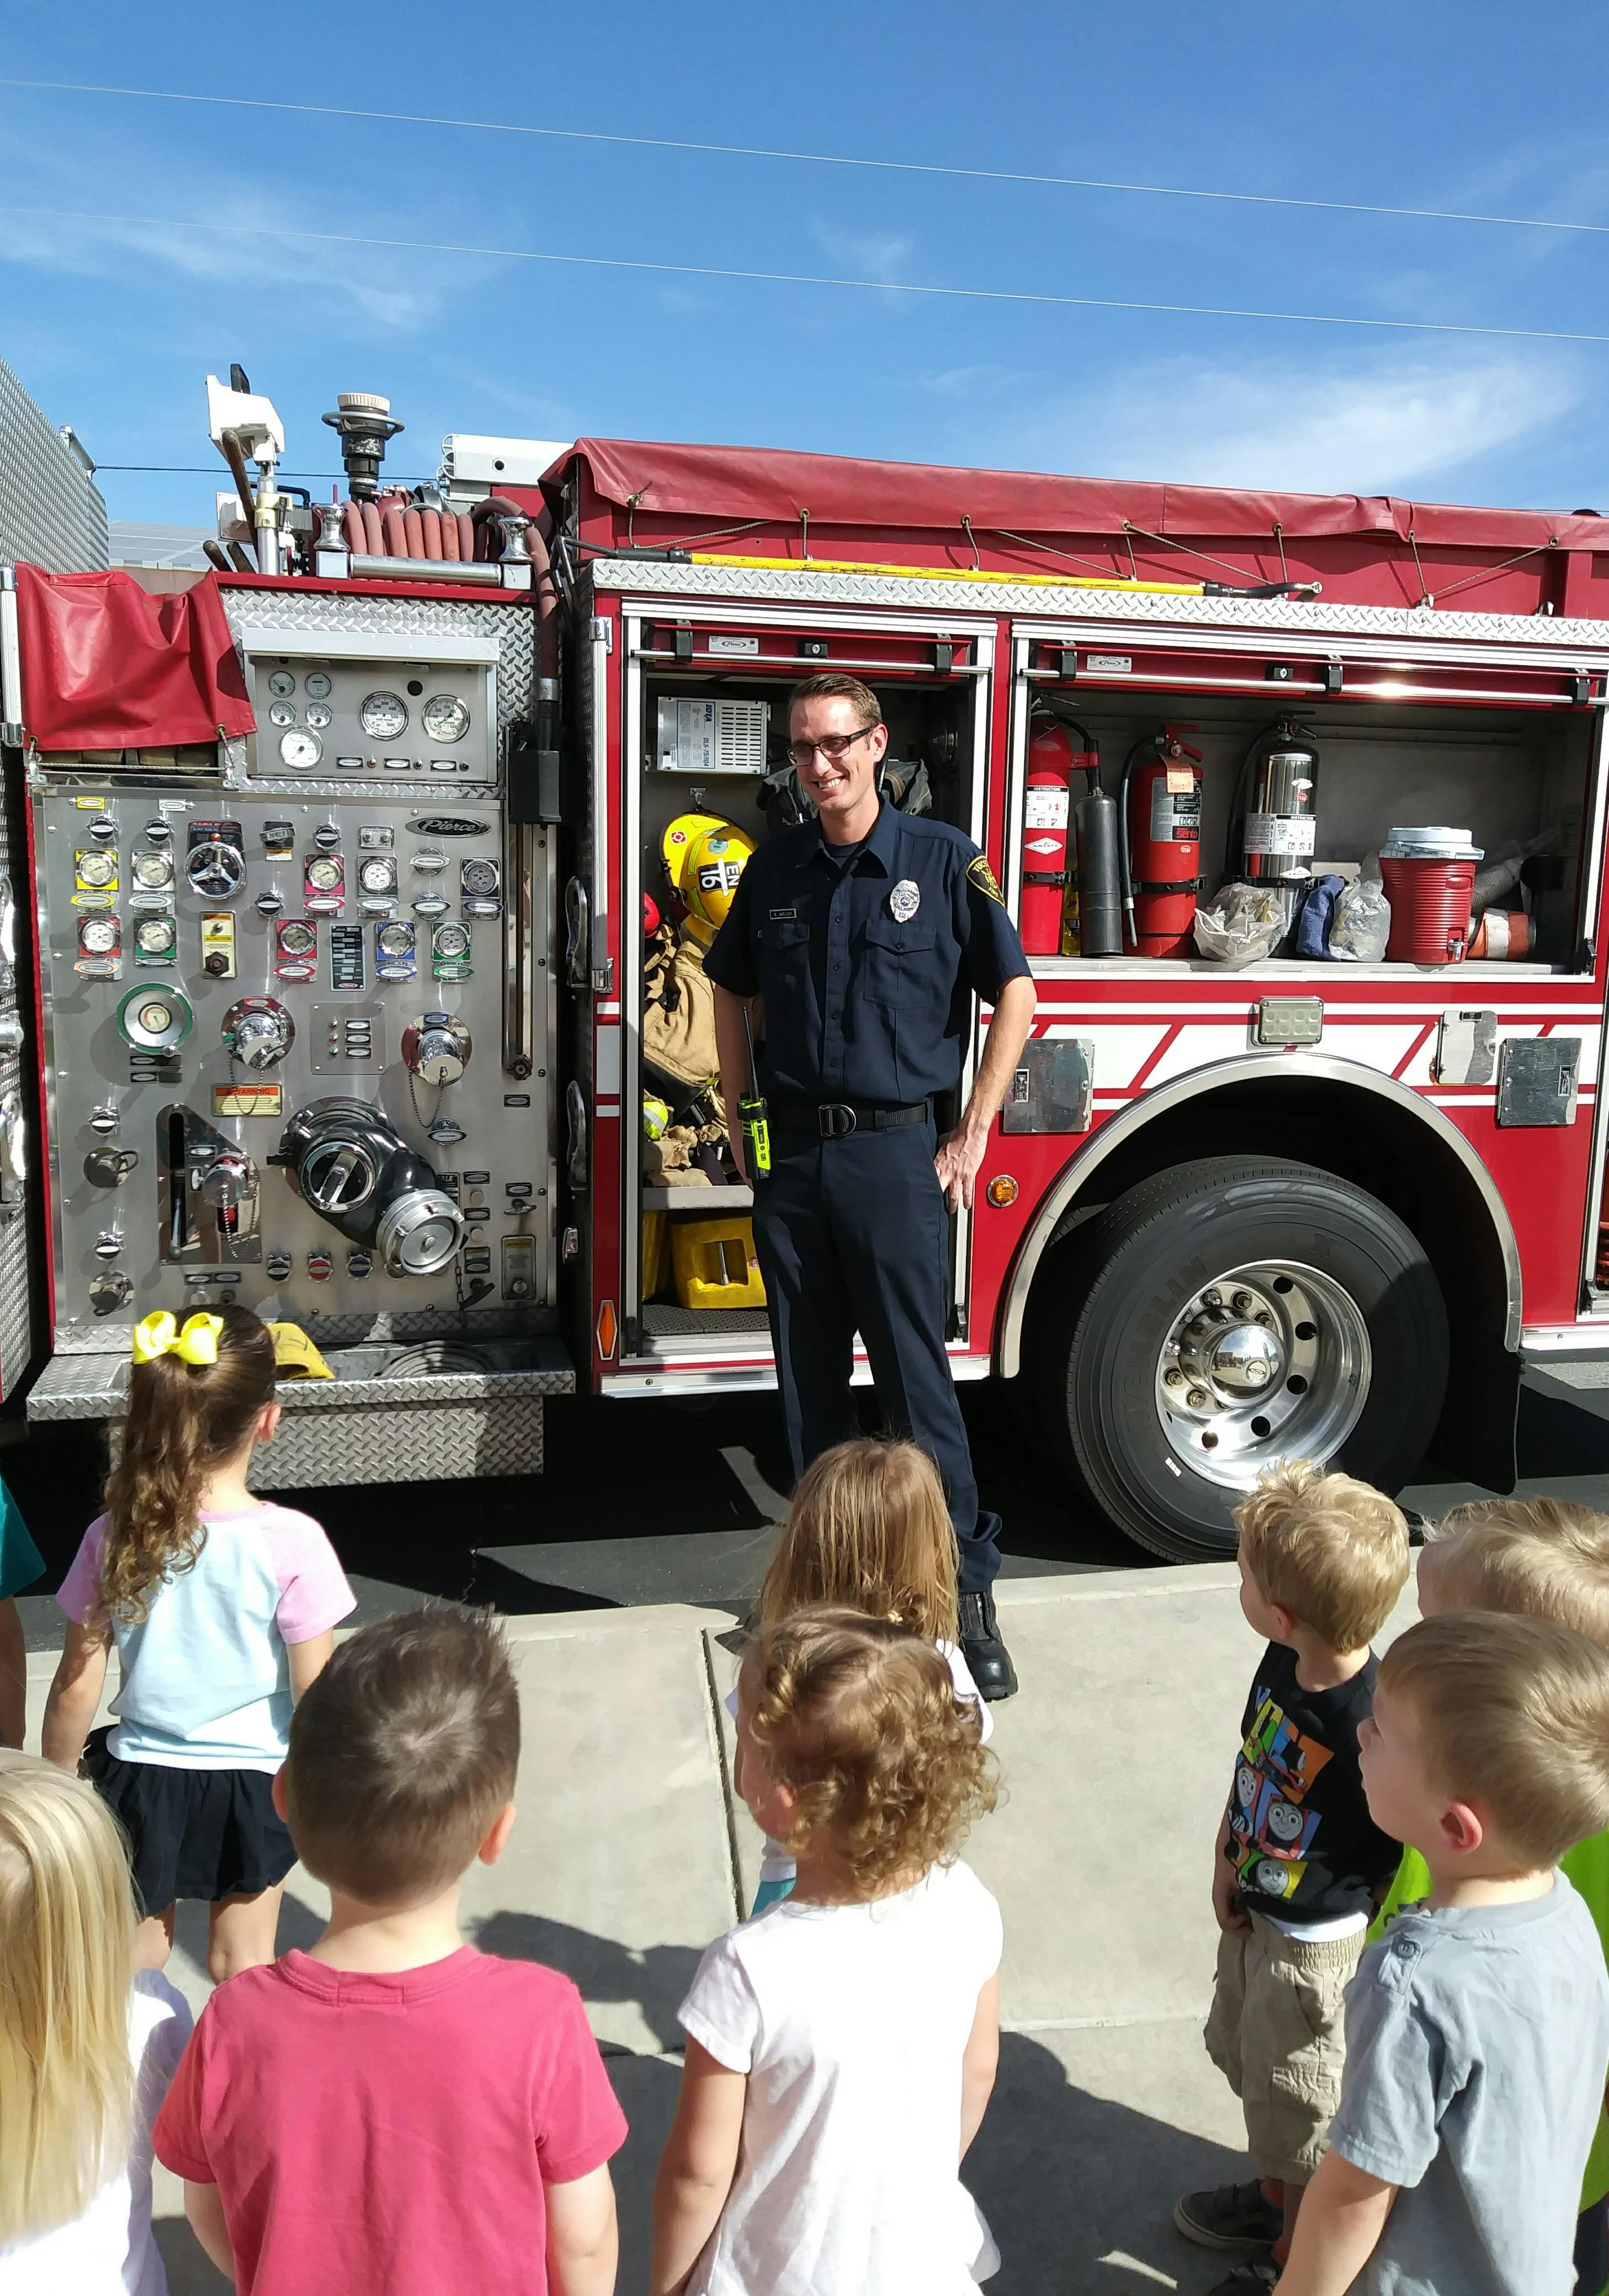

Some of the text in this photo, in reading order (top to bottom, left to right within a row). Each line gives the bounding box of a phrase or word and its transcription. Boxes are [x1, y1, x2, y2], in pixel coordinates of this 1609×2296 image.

[421, 820, 476, 831] Pierce
[972, 860, 990, 873] TUCS
[726, 864, 741, 887] EN
